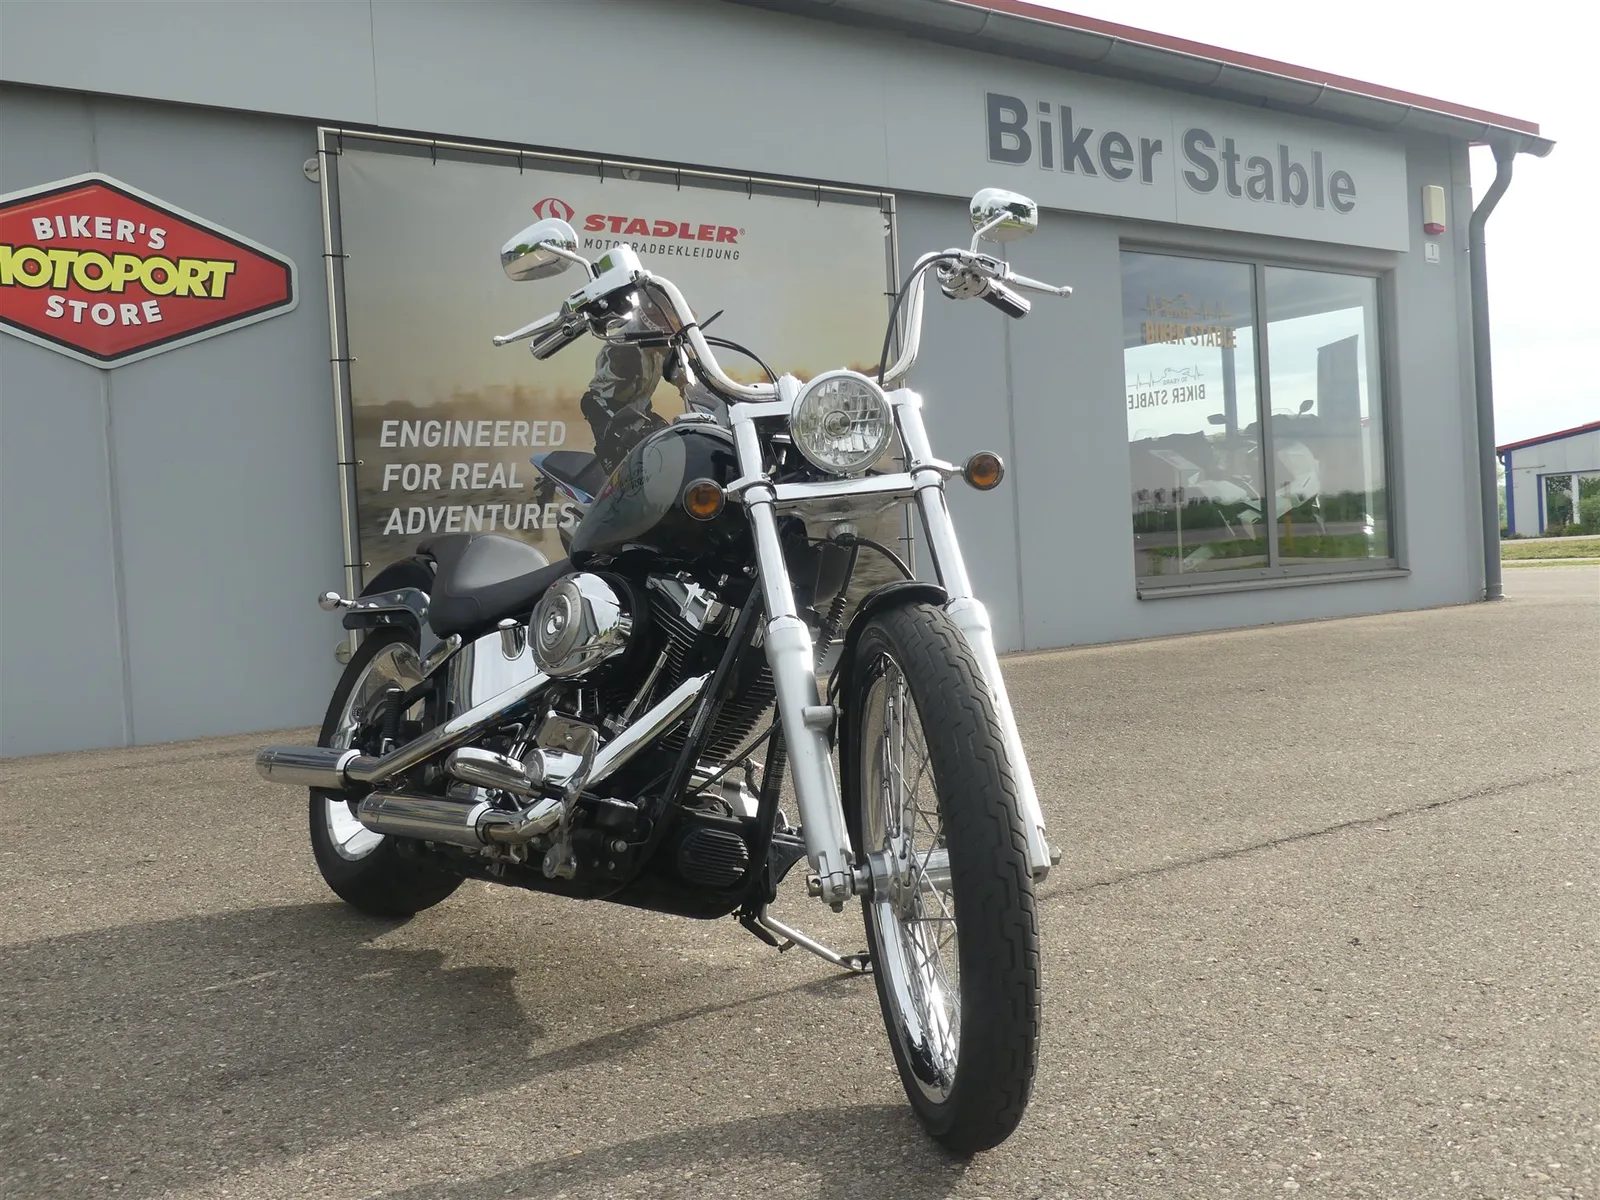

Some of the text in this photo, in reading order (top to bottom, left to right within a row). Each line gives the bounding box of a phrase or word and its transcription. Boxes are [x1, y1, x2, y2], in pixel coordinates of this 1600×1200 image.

[985, 91, 1357, 215] Biker Stable
[31, 215, 167, 250] BIKER'S
[584, 238, 740, 260] MOTORADBEKLEIDUNG
[45, 295, 163, 326] STORE
[380, 420, 567, 448] ENGINEERED
[382, 462, 524, 492] FOR REAL
